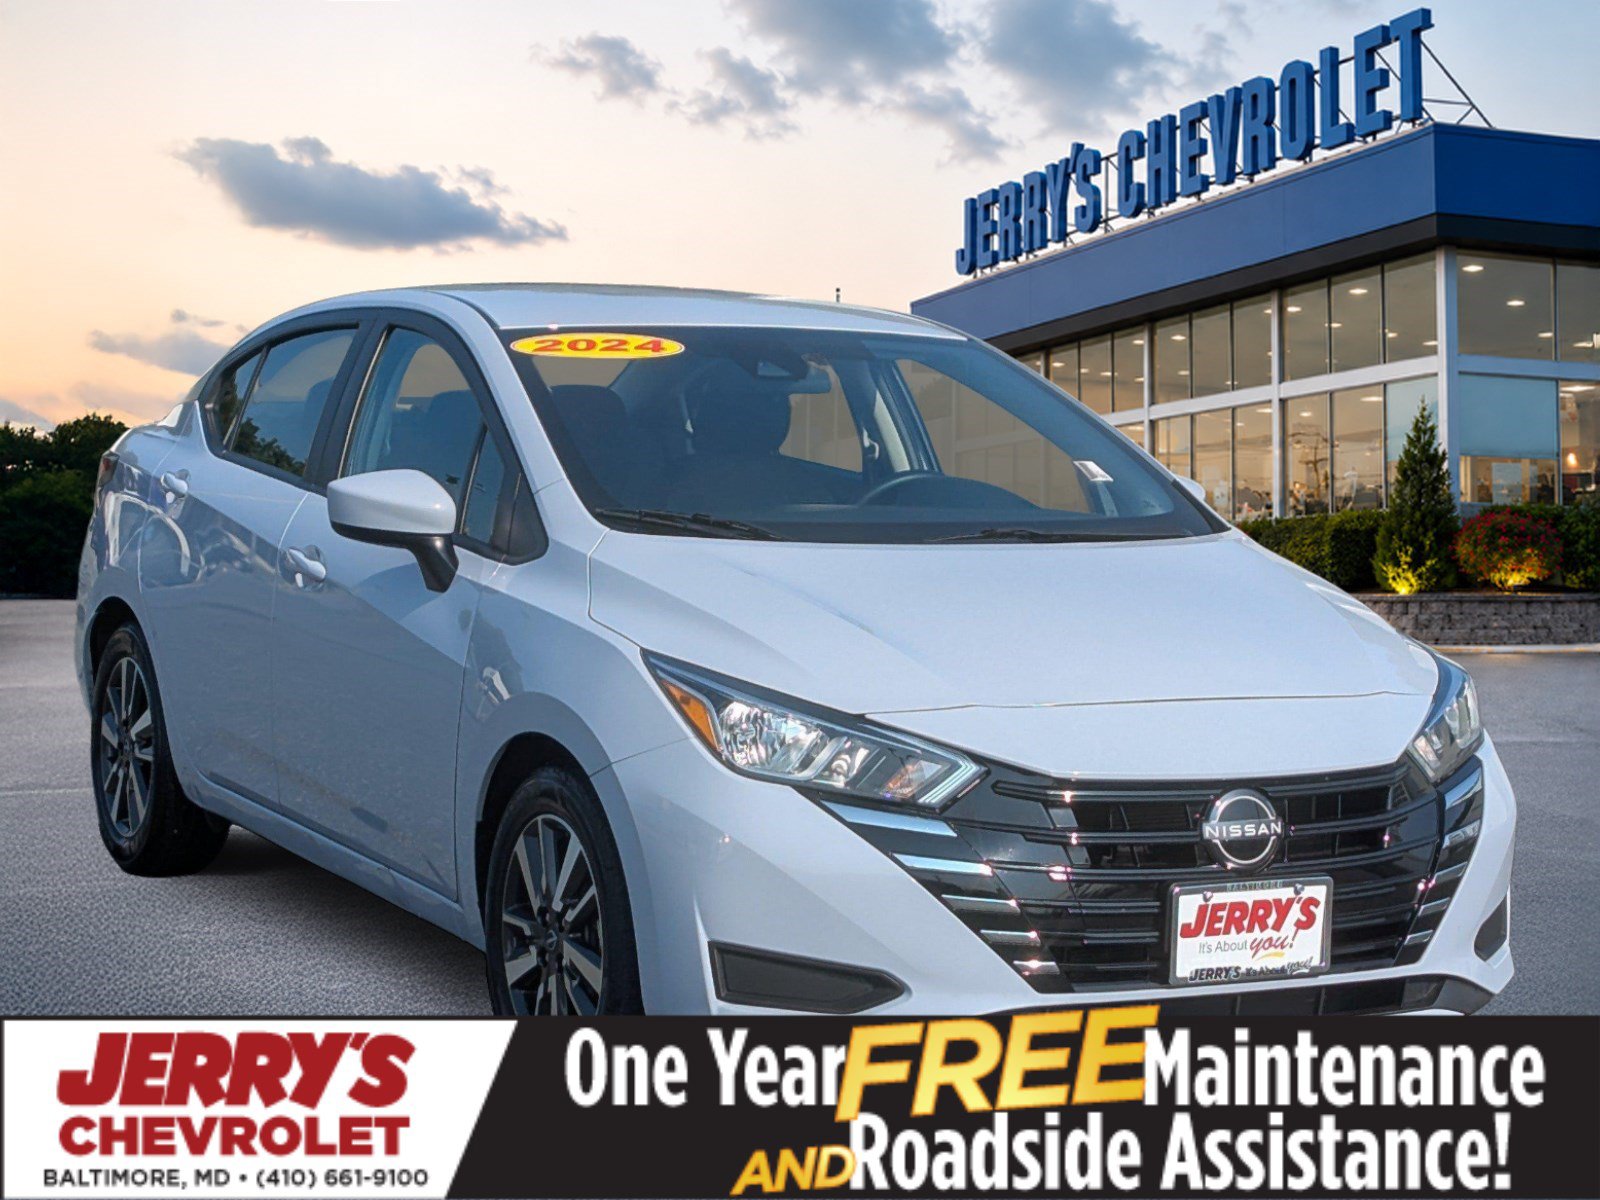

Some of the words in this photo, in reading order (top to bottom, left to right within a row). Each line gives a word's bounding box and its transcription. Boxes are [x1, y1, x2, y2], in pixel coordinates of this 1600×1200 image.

[956, 143, 1101, 275] JERRY'S
[1117, 7, 1434, 218] CHEVROLET
[531, 338, 666, 353] 2024
[1204, 821, 1282, 838] NISSAN
[1180, 896, 1321, 938] JERRY'S
[1199, 941, 1213, 954] It's
[1215, 939, 1248, 953] About
[1249, 928, 1300, 959] you!
